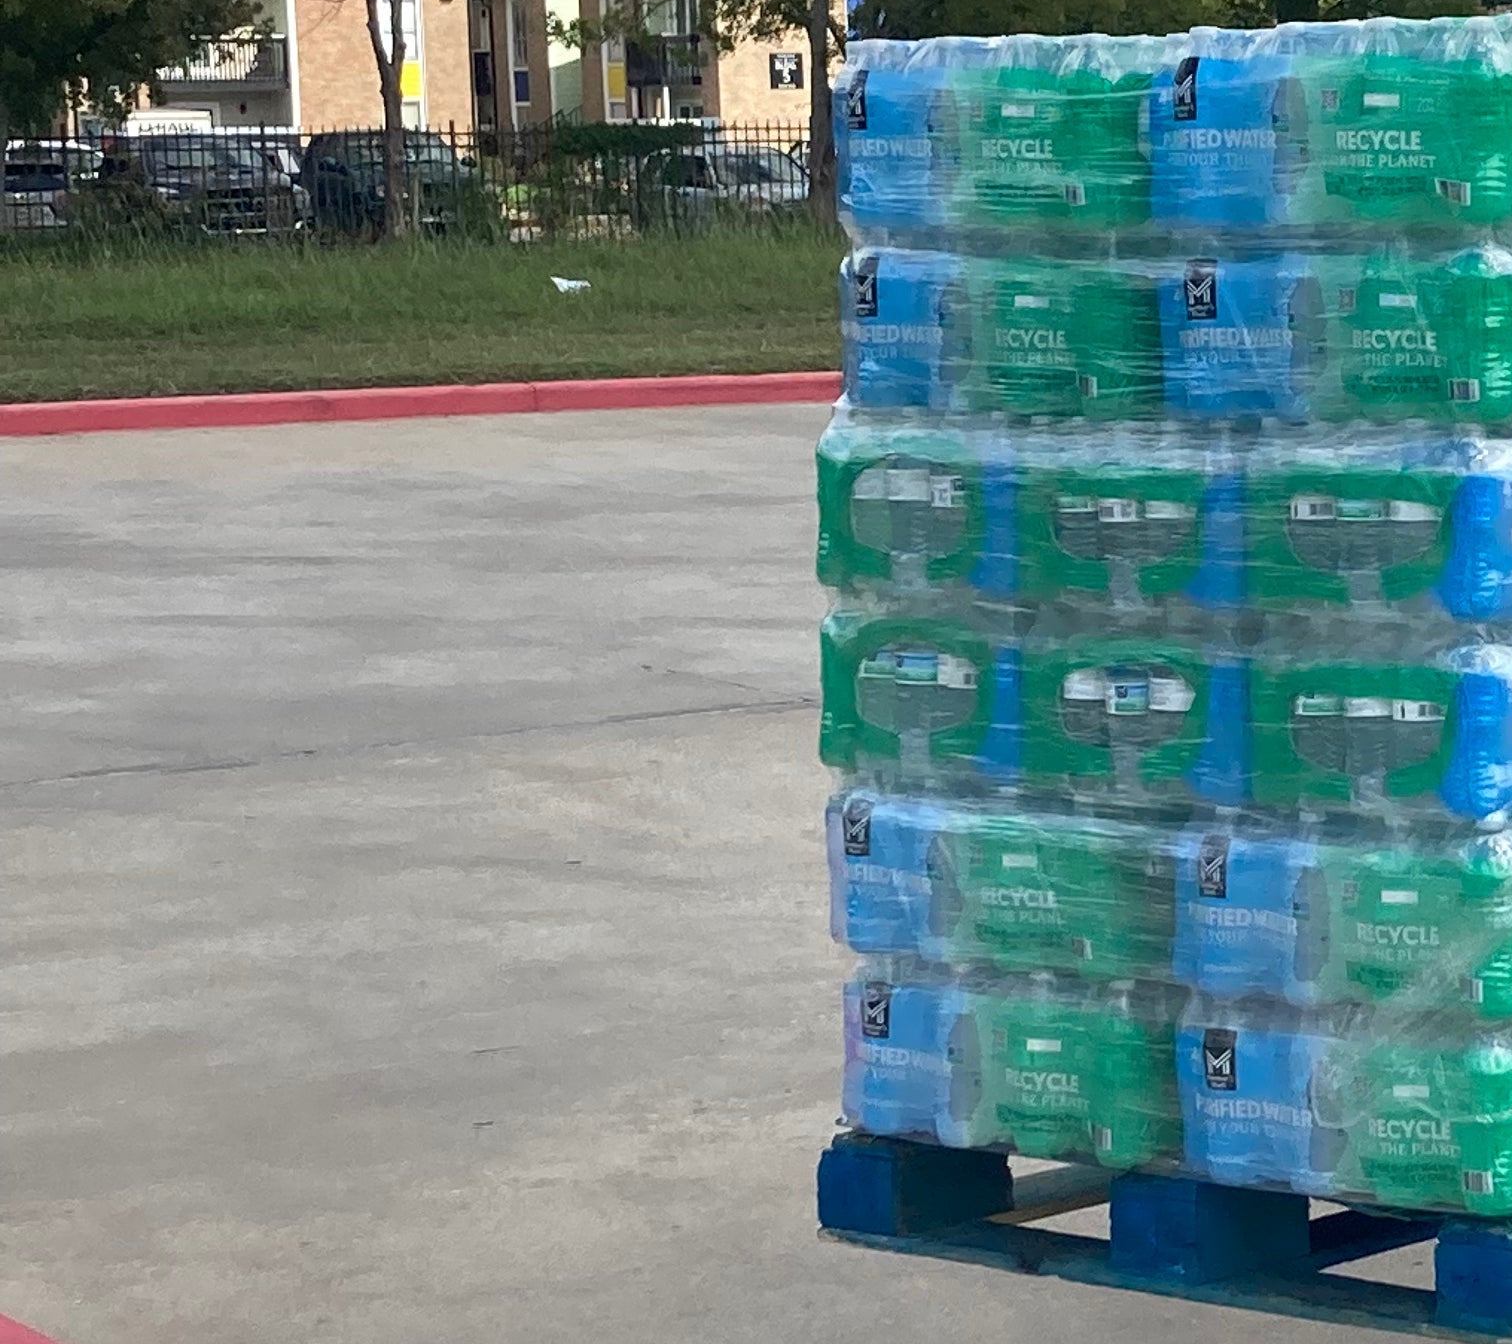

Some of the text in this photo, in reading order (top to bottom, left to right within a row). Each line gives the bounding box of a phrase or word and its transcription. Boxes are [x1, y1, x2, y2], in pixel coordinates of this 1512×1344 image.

[1336, 130, 1422, 151] RECYCLE
[1352, 329, 1438, 350] RECYCLE
[1368, 1118, 1451, 1141] RECYCLE
